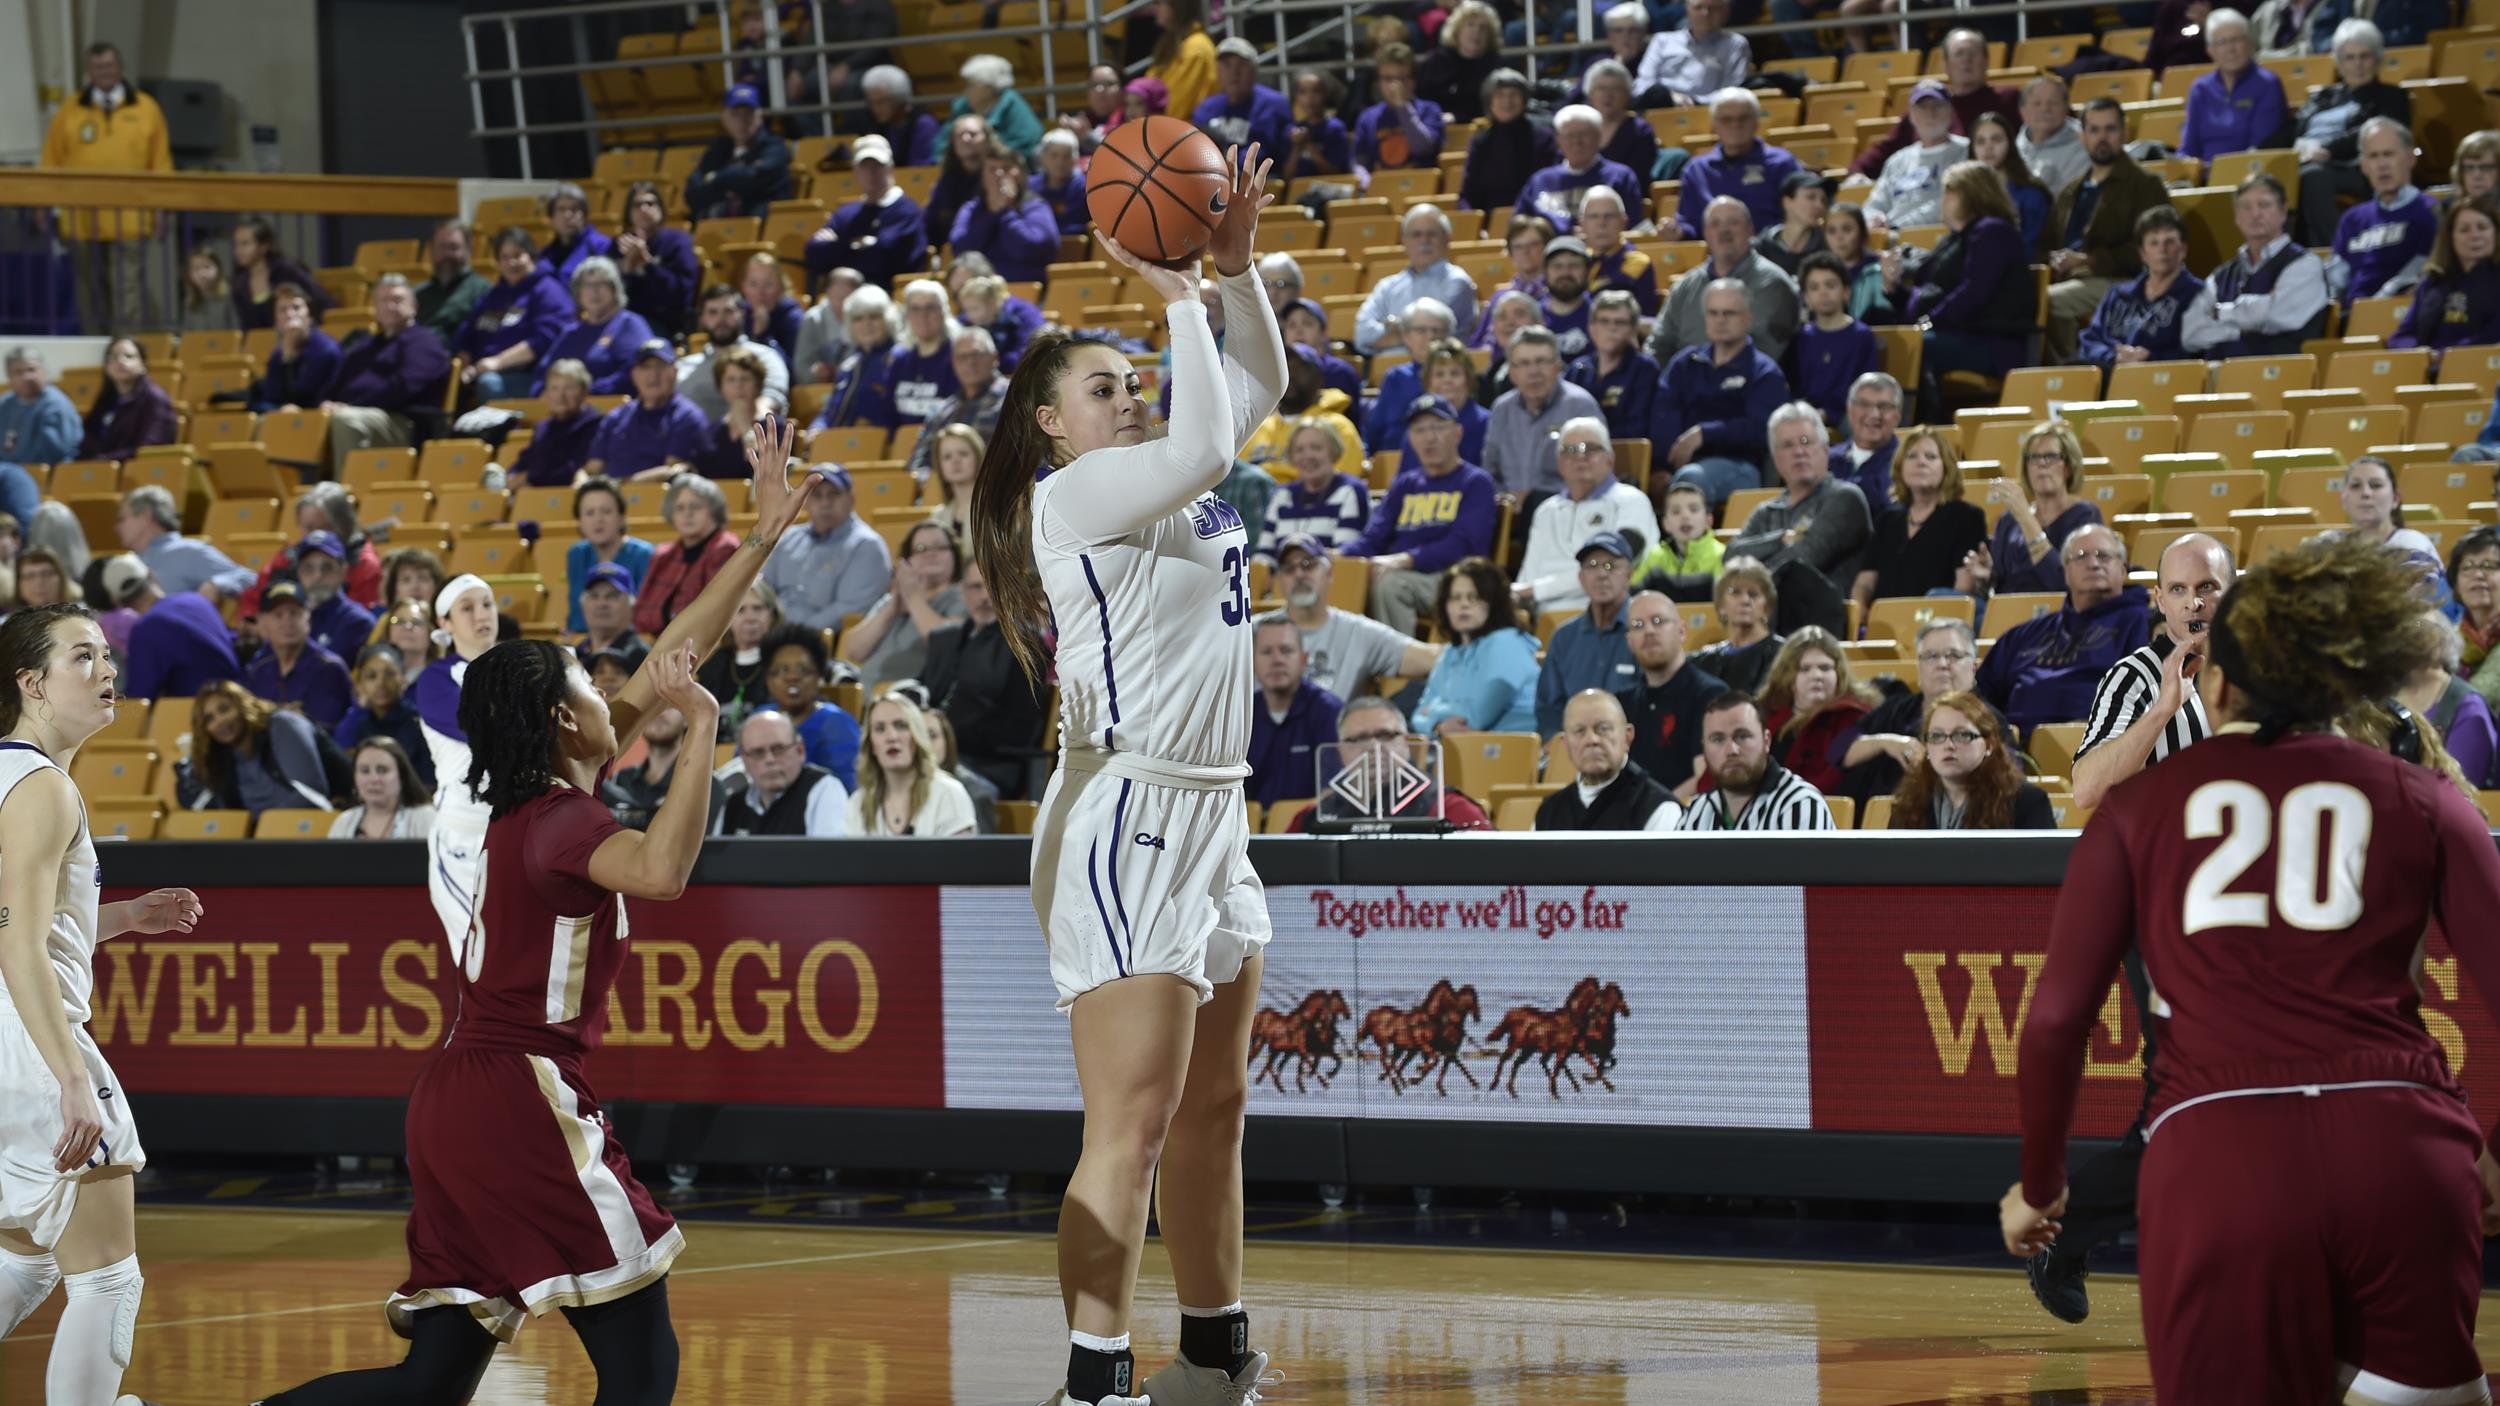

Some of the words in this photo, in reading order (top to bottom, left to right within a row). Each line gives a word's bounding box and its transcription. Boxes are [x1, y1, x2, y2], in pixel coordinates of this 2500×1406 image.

[1192, 496, 1244, 539] JM
[1397, 491, 1462, 526] JMU
[1134, 832, 1165, 850] CAA
[2183, 779, 2373, 935] 20
[1311, 886, 1448, 938] Together
[1457, 885, 1528, 929] we'll
[1535, 900, 1576, 939] go
[1582, 886, 1628, 929] far
[89, 940, 442, 1049] WELLS
[602, 940, 879, 1052] RGO
